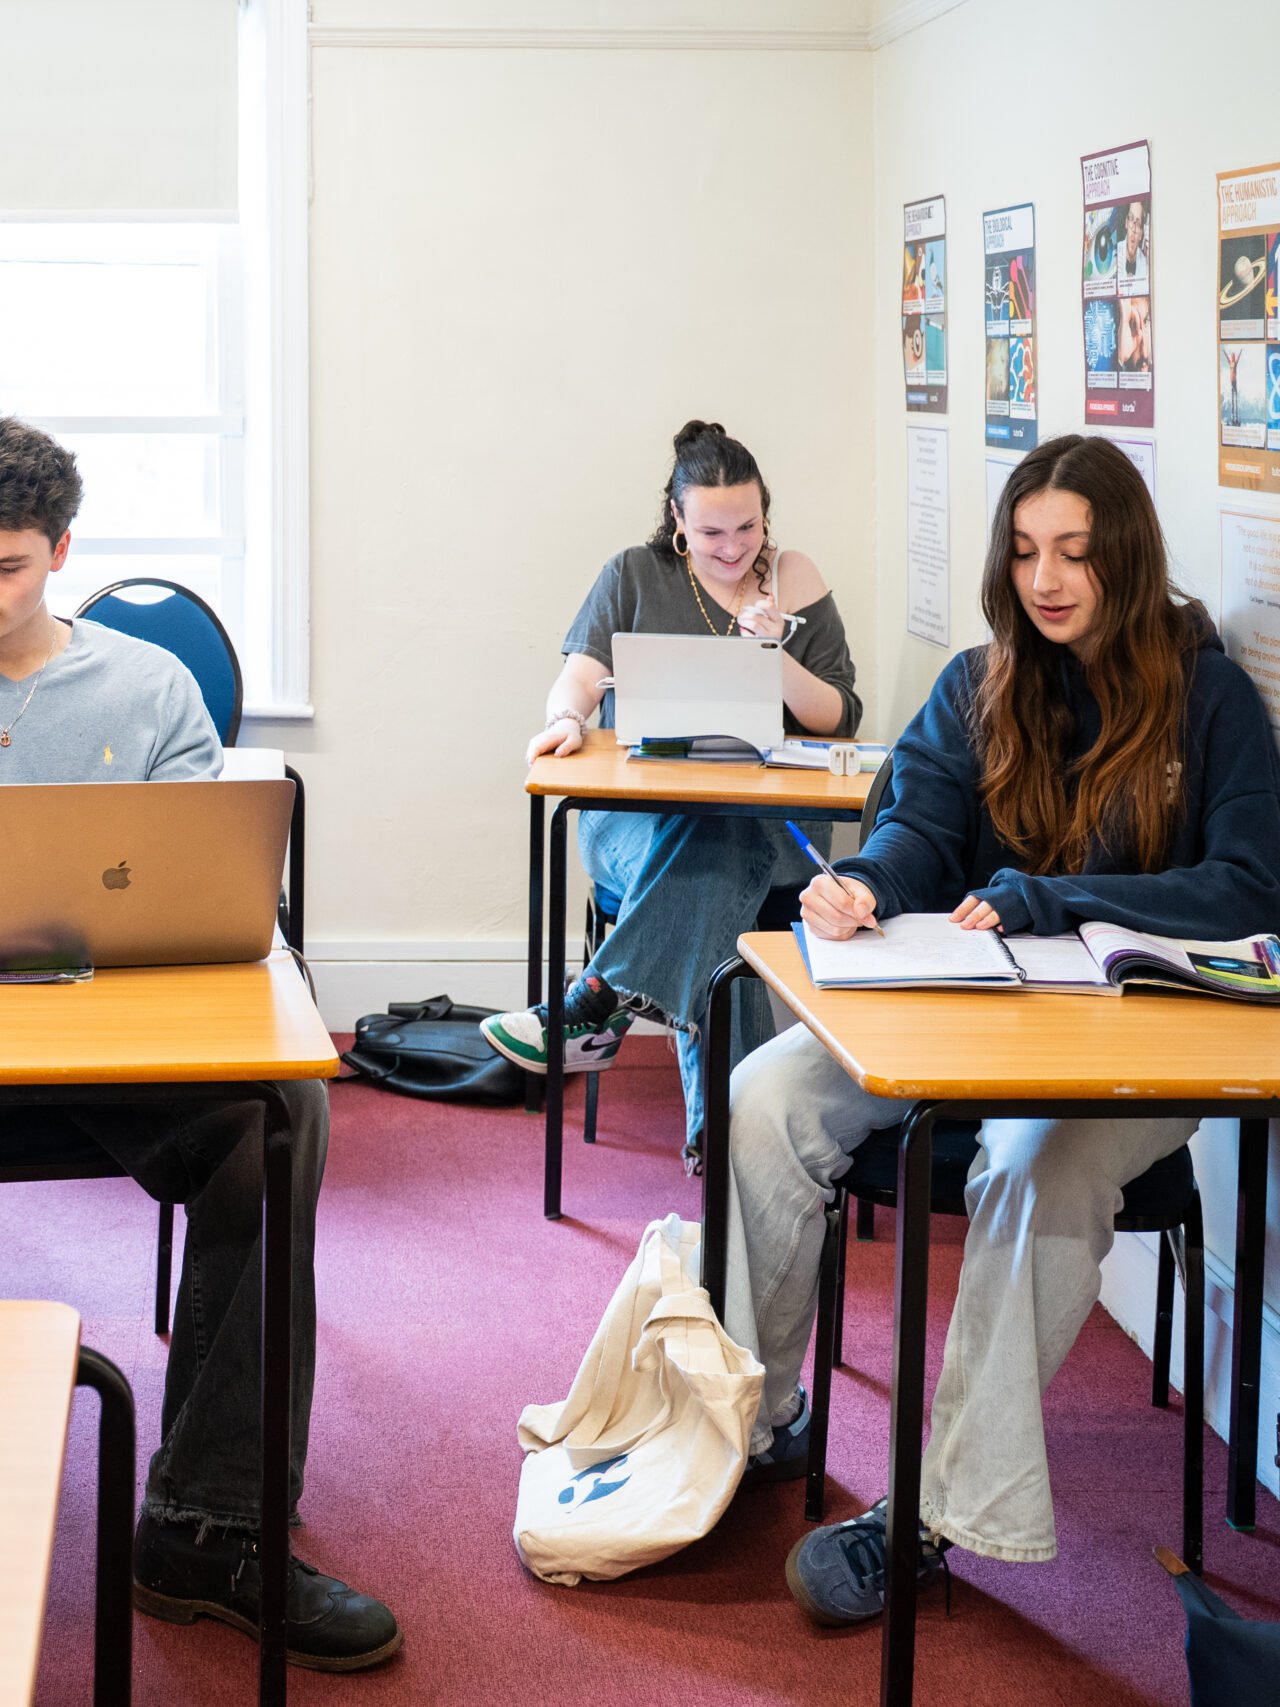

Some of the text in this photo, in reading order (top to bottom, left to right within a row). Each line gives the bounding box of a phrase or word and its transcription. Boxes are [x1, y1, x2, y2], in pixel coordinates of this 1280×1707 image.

[1085, 158, 1119, 181] THE COGNITIVE
[1086, 179, 1110, 199] APPROACH
[1221, 177, 1278, 203] THE HUMANISTIC
[1222, 202, 1257, 224] APPROACH
